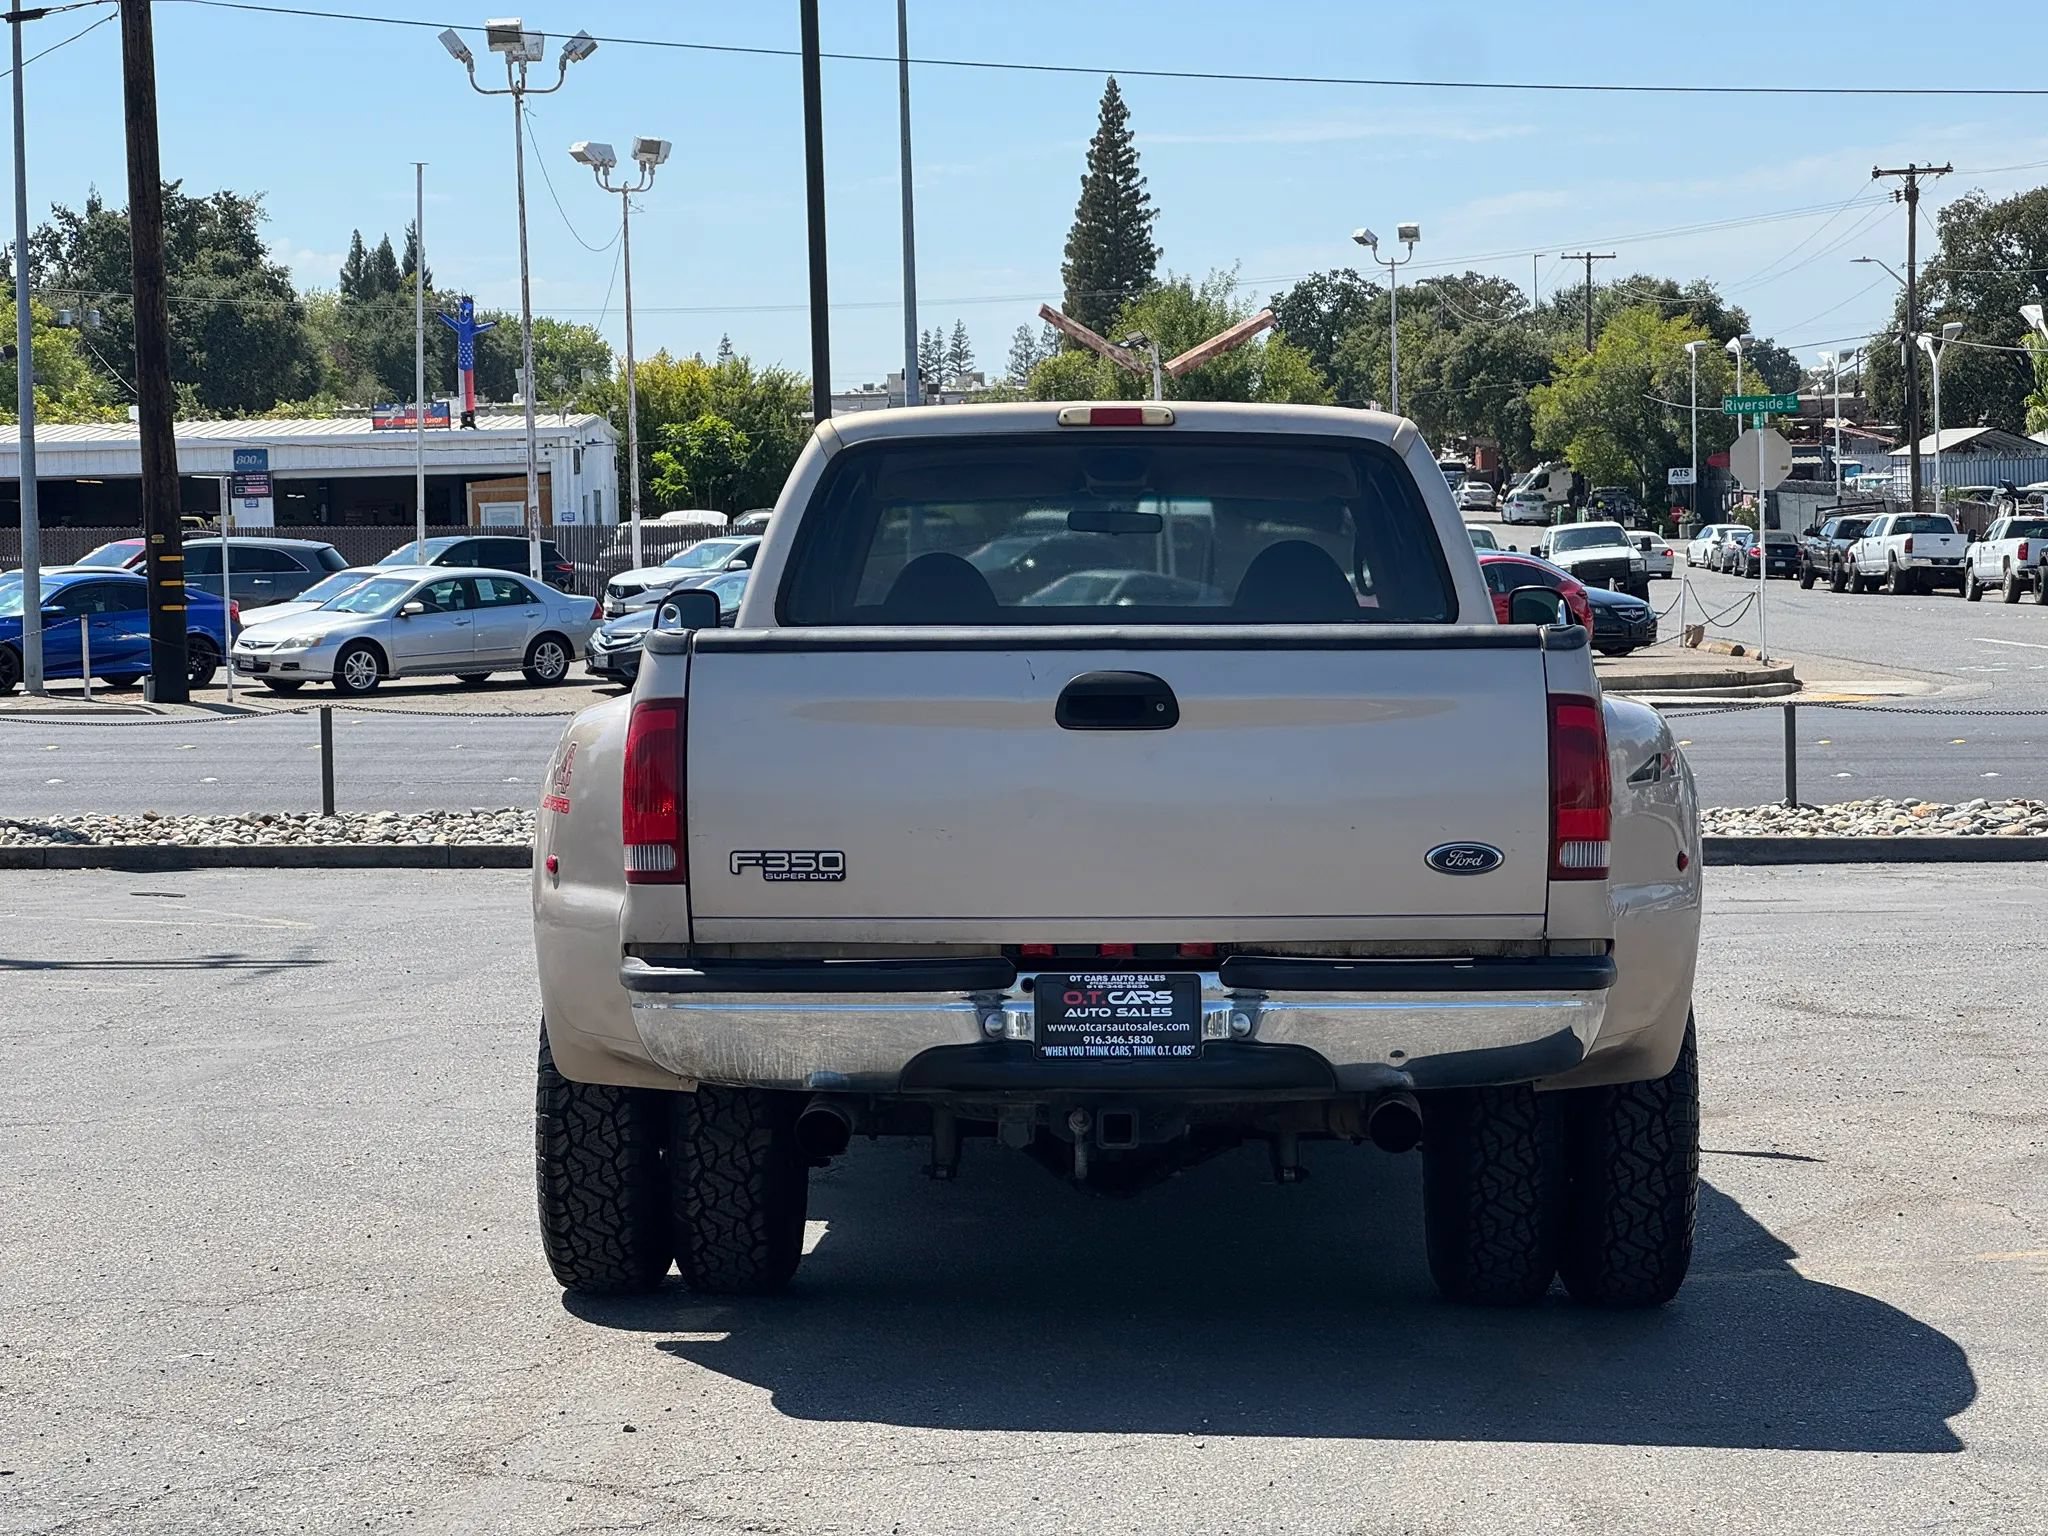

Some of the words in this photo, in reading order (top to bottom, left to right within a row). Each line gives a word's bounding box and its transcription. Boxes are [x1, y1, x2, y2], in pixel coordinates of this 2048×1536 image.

[404, 402, 432, 410] PATOT
[1724, 397, 1784, 411] Riverside
[1672, 468, 1690, 478] ATS
[1445, 849, 1484, 866] Ford
[765, 872, 806, 880] SUPER
[810, 872, 843, 880] DUTY
[1137, 974, 1166, 982] SALES
[1063, 991, 1106, 1005] O.T.
[1107, 990, 1174, 1005] CARS
[1064, 1007, 1112, 1018] AUTO
[1115, 1007, 1173, 1017] SALES
[1047, 1021, 1190, 1032] www.otcarsautosales.com
[1082, 1035, 1154, 1045] 916.346.5830
[1069, 1046, 1084, 1056] YOU
[1085, 1046, 1109, 1056] THINK
[1110, 1046, 1132, 1057] CARS,
[1133, 1046, 1156, 1056] THINK
[1157, 1046, 1172, 1056] O.T.
